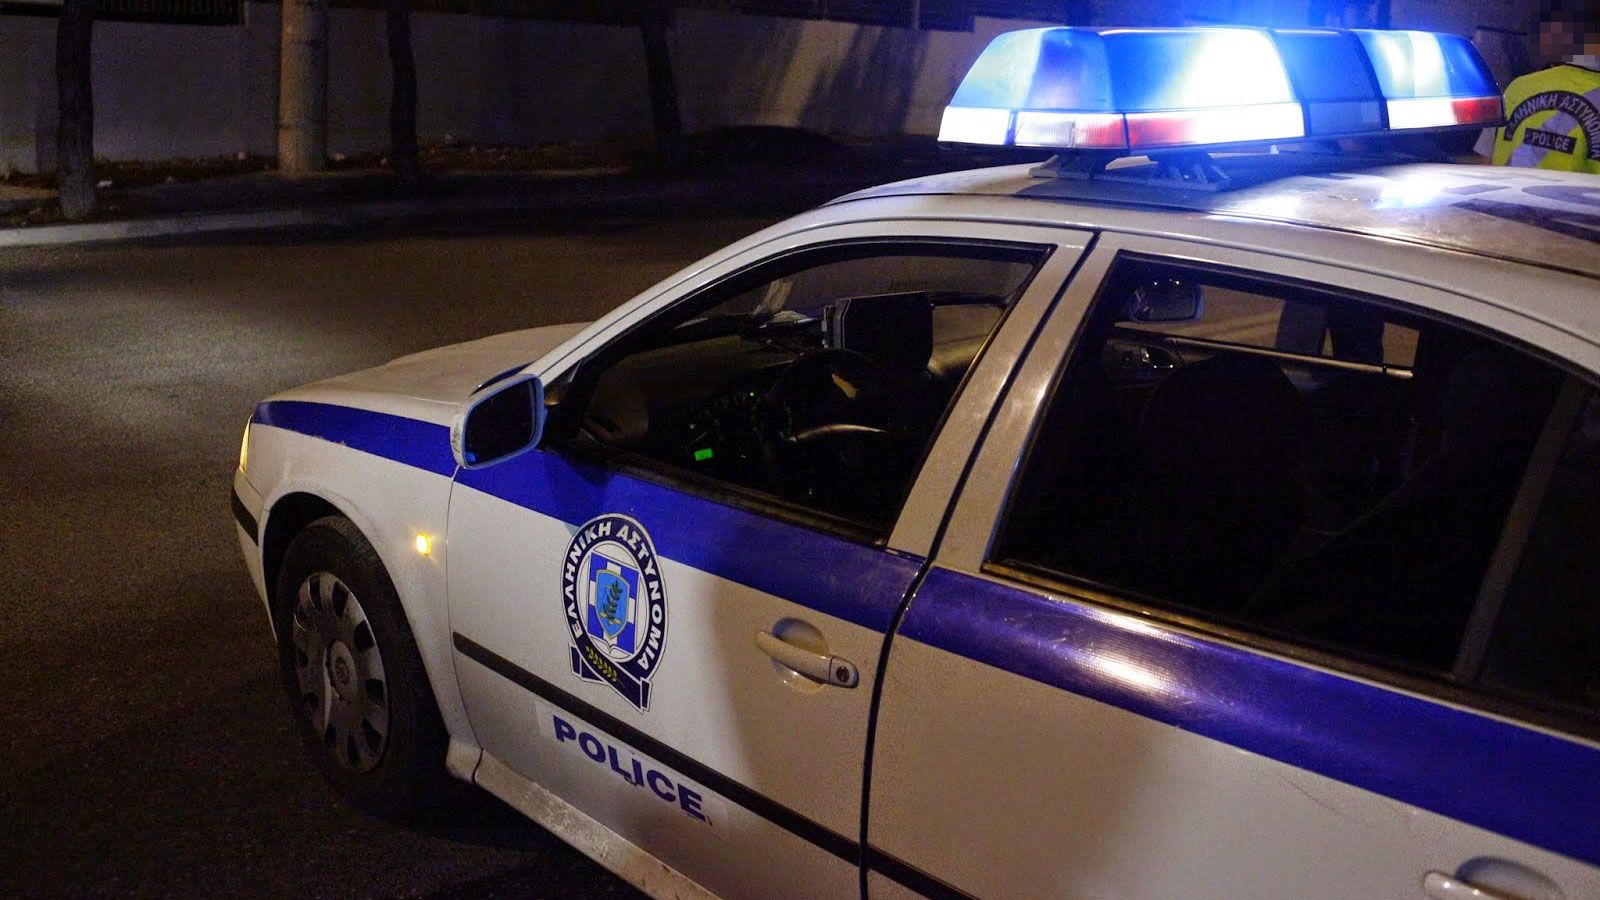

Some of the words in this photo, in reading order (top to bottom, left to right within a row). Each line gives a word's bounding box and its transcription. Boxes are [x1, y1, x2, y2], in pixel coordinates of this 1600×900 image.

[1531, 131, 1569, 151] POLICE
[564, 521, 612, 640] ΕΛΛΗΝΙΚΗ
[616, 525, 663, 671] ΑΣΤΥΝΟΜΙΑ
[552, 714, 707, 823] POLICE
